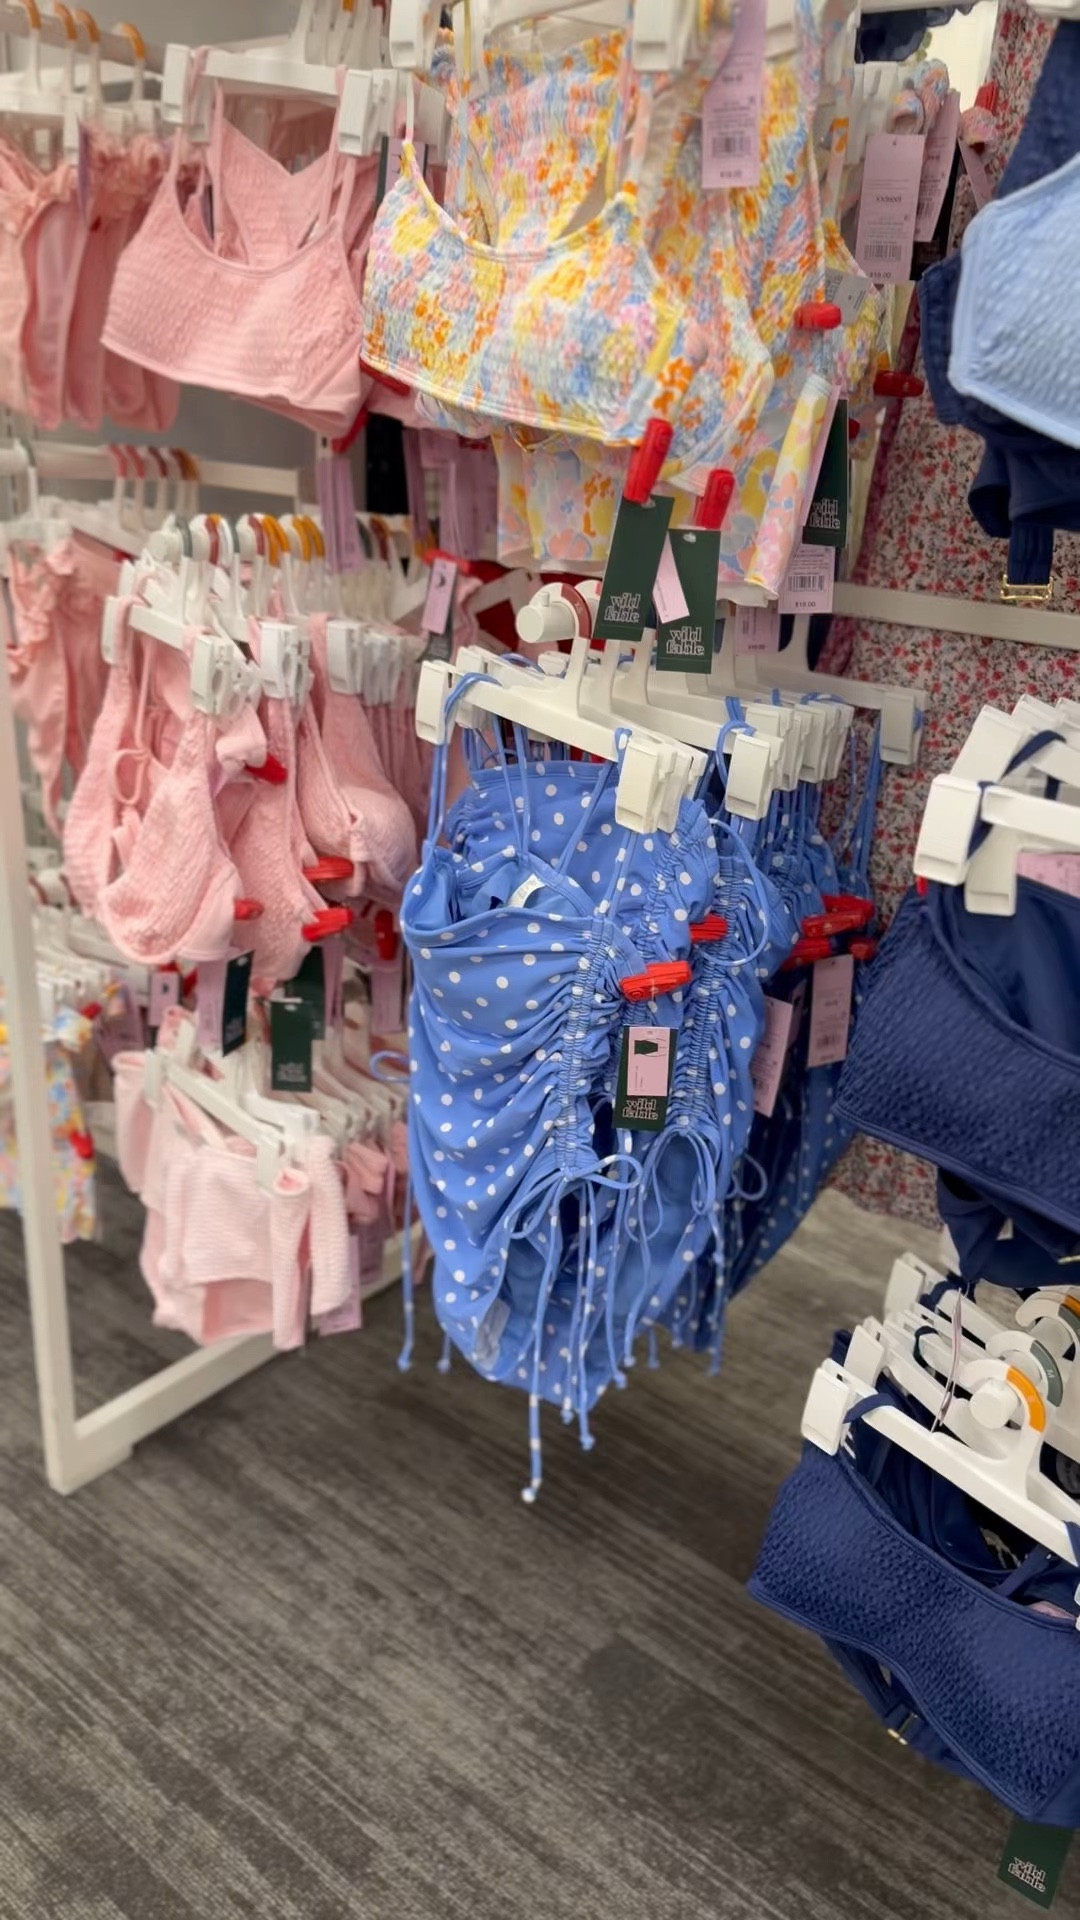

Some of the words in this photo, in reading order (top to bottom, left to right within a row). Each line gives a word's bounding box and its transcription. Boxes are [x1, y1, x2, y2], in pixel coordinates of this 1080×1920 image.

[610, 592, 641, 609] wild
[603, 605, 640, 623] fable
[669, 626, 702, 642] wild
[666, 639, 705, 656] fable
[626, 1098, 657, 1111] wild
[622, 1106, 659, 1121] fable
[1008, 1863, 1046, 1892] fable
[1014, 1857, 1046, 1881] wild
